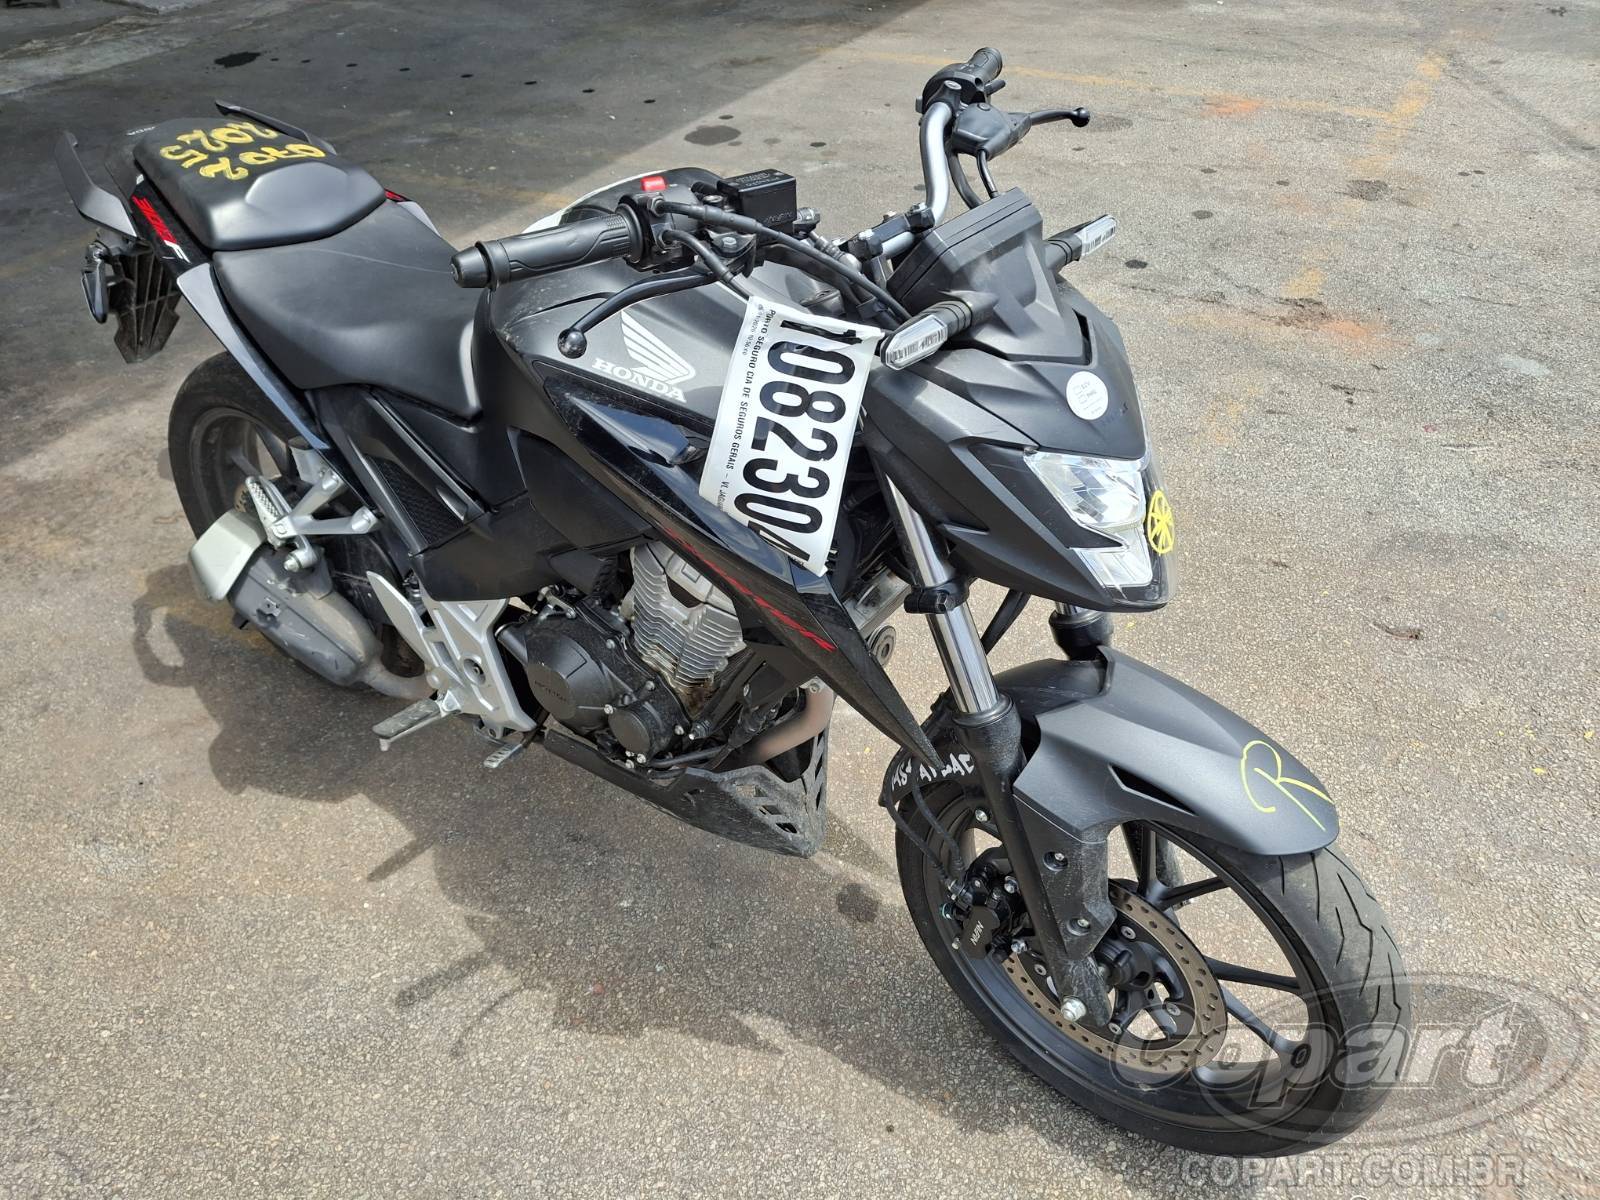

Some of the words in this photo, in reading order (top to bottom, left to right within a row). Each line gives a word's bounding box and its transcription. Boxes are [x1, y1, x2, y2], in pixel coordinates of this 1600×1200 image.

[760, 309, 776, 334] PORTO
[748, 336, 765, 369] SEGURO
[591, 357, 687, 404] HONDA
[741, 386, 751, 399] DE
[744, 371, 755, 385] CIA
[733, 401, 749, 441] SEGUROS
[726, 442, 740, 470] GERAIS
[1240, 739, 1336, 831] R
